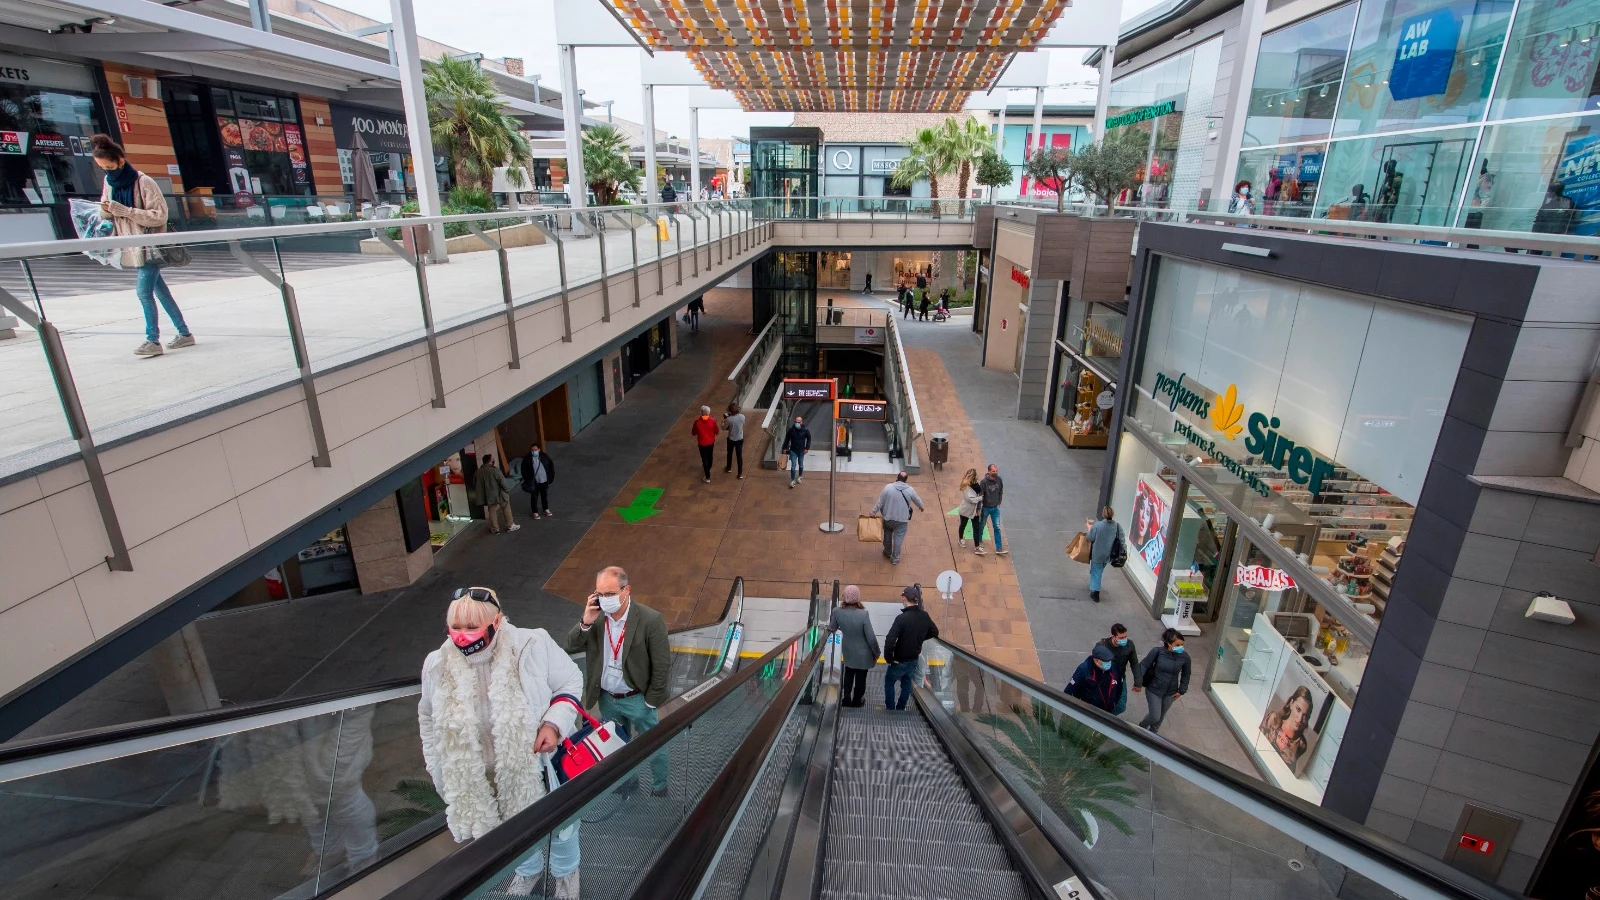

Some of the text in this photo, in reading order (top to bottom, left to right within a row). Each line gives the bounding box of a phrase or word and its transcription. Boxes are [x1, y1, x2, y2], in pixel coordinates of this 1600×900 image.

[1404, 18, 1432, 41] AW
[1400, 39, 1429, 60] LAB
[352, 117, 375, 134] 100
[833, 149, 854, 170] Q
[873, 160, 901, 170] MASQ
[1152, 372, 1335, 496] perfums Sirer
[1174, 420, 1270, 498] perfums & cosmetics
[1236, 566, 1289, 589] REBAJAS
[1182, 602, 1192, 619] Sirer
